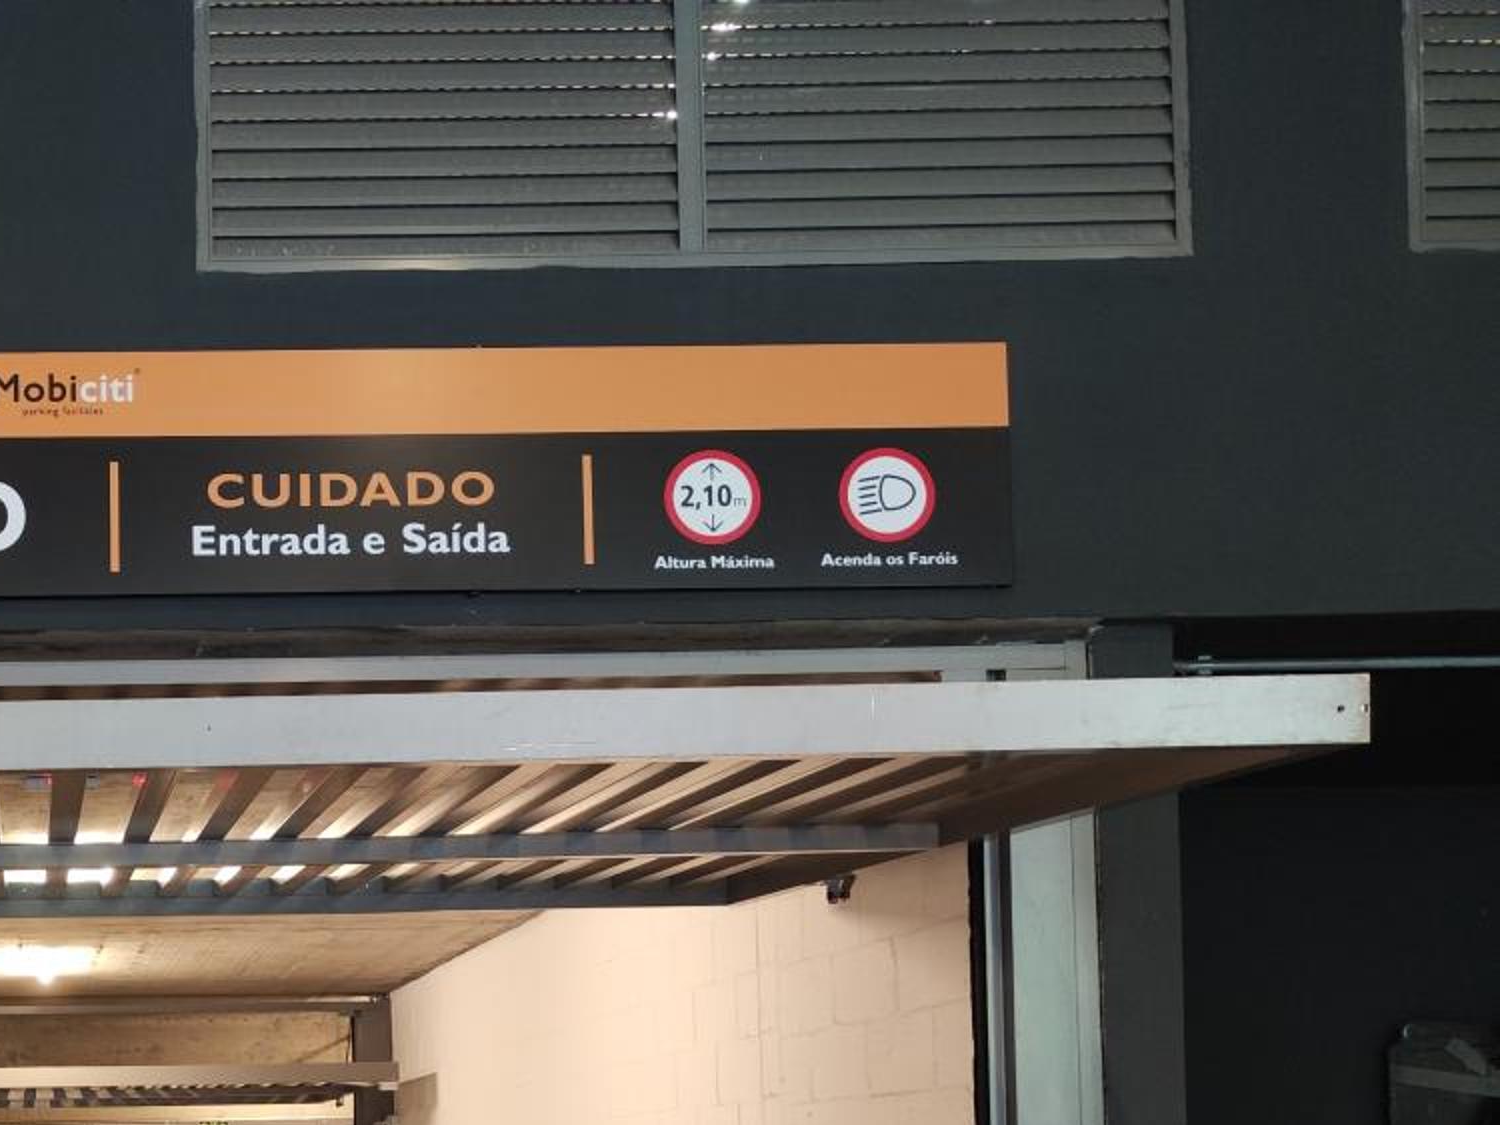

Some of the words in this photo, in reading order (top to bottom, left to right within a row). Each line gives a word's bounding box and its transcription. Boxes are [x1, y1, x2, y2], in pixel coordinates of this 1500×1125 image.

[207, 471, 495, 508] CUIDADO
[191, 523, 351, 557] Entrada
[362, 532, 386, 555] e
[401, 521, 511, 555] Saída
[654, 555, 707, 570] Altura
[710, 553, 775, 569] Máxima
[820, 552, 882, 568] Acenda
[885, 555, 905, 567] os
[908, 551, 959, 567] Faróis
